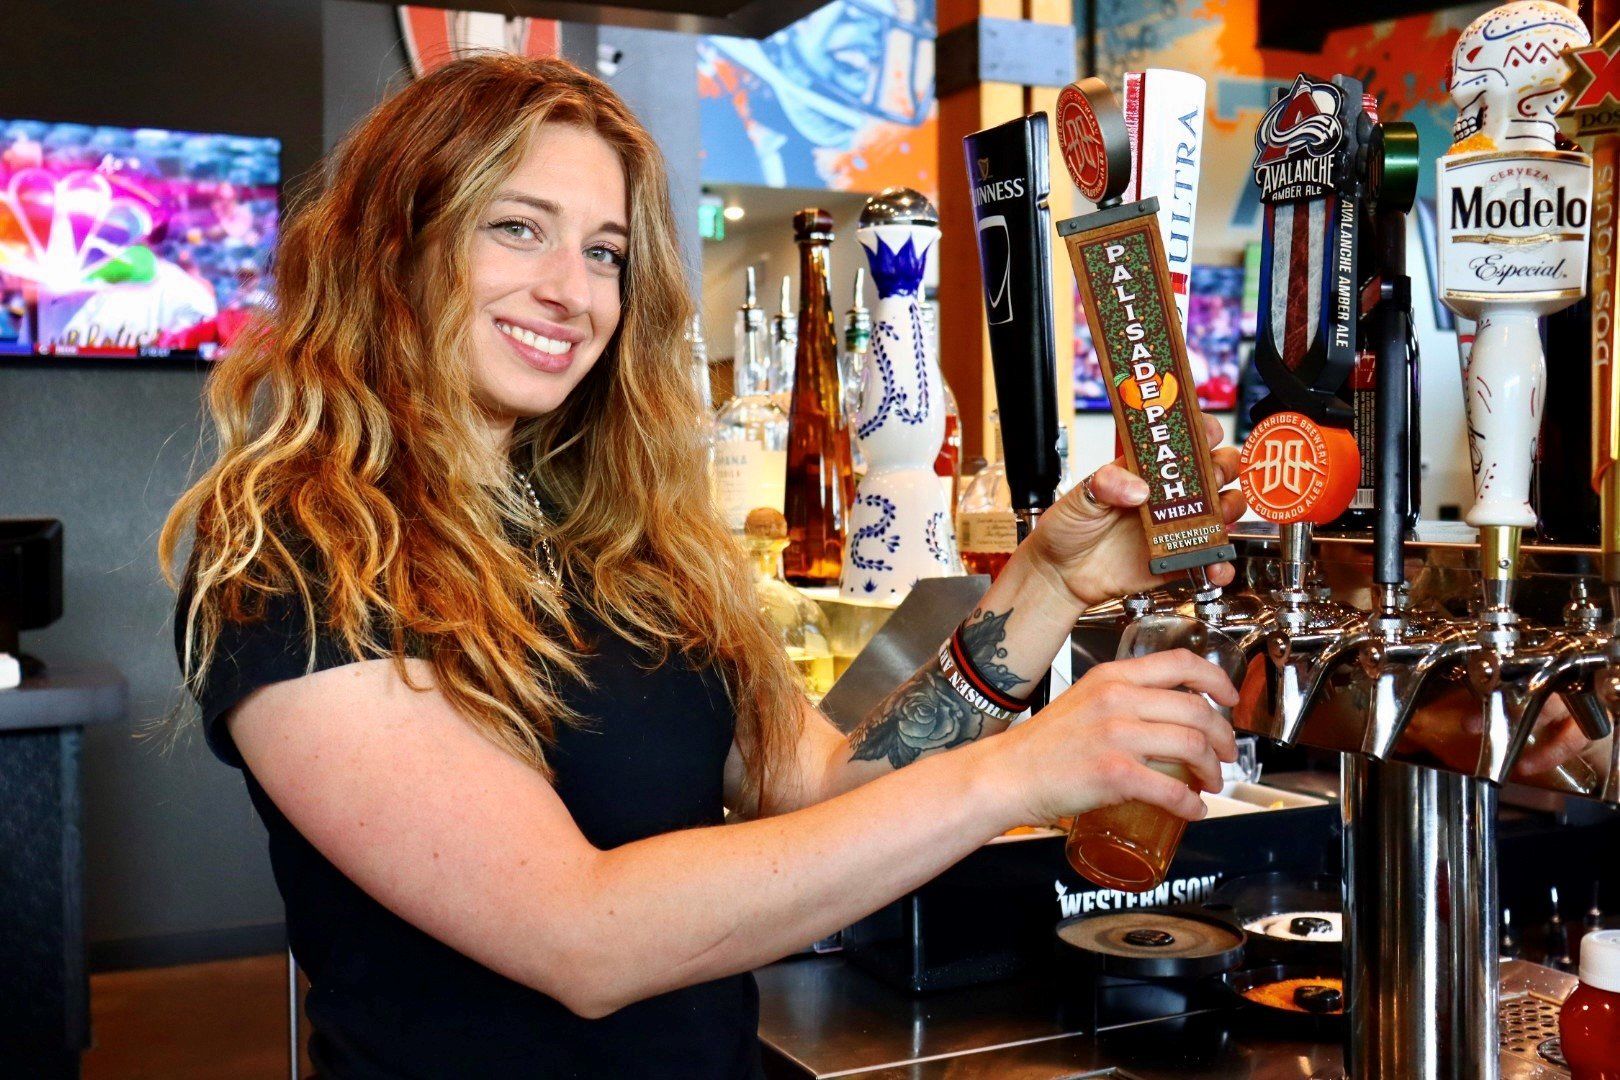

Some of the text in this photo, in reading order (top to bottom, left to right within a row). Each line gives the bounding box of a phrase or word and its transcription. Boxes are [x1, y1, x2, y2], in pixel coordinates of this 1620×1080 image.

[973, 178, 1024, 208] UINNESS
[1168, 104, 1199, 264] ULTRA
[1255, 154, 1336, 200] AVALANCHE
[1272, 185, 1322, 201] AMBER ALE
[1490, 167, 1550, 182] CERVEZA
[1450, 186, 1588, 230] Modelo
[1335, 199, 1354, 348] AVALANCHE AMBER ALE
[1469, 254, 1566, 285] Especial
[1593, 289, 1611, 368] DOS
[1105, 244, 1187, 501] PALISADE PEACH
[1240, 414, 1298, 464] BRECKENRIDGE
[1299, 419, 1328, 466] BREWERY
[1153, 501, 1204, 521] WHEAT
[1241, 480, 1324, 520] FINE COLORADO ALES
[1152, 524, 1222, 545] BRECKENRIDGE
[1166, 535, 1210, 551] BREWERY
